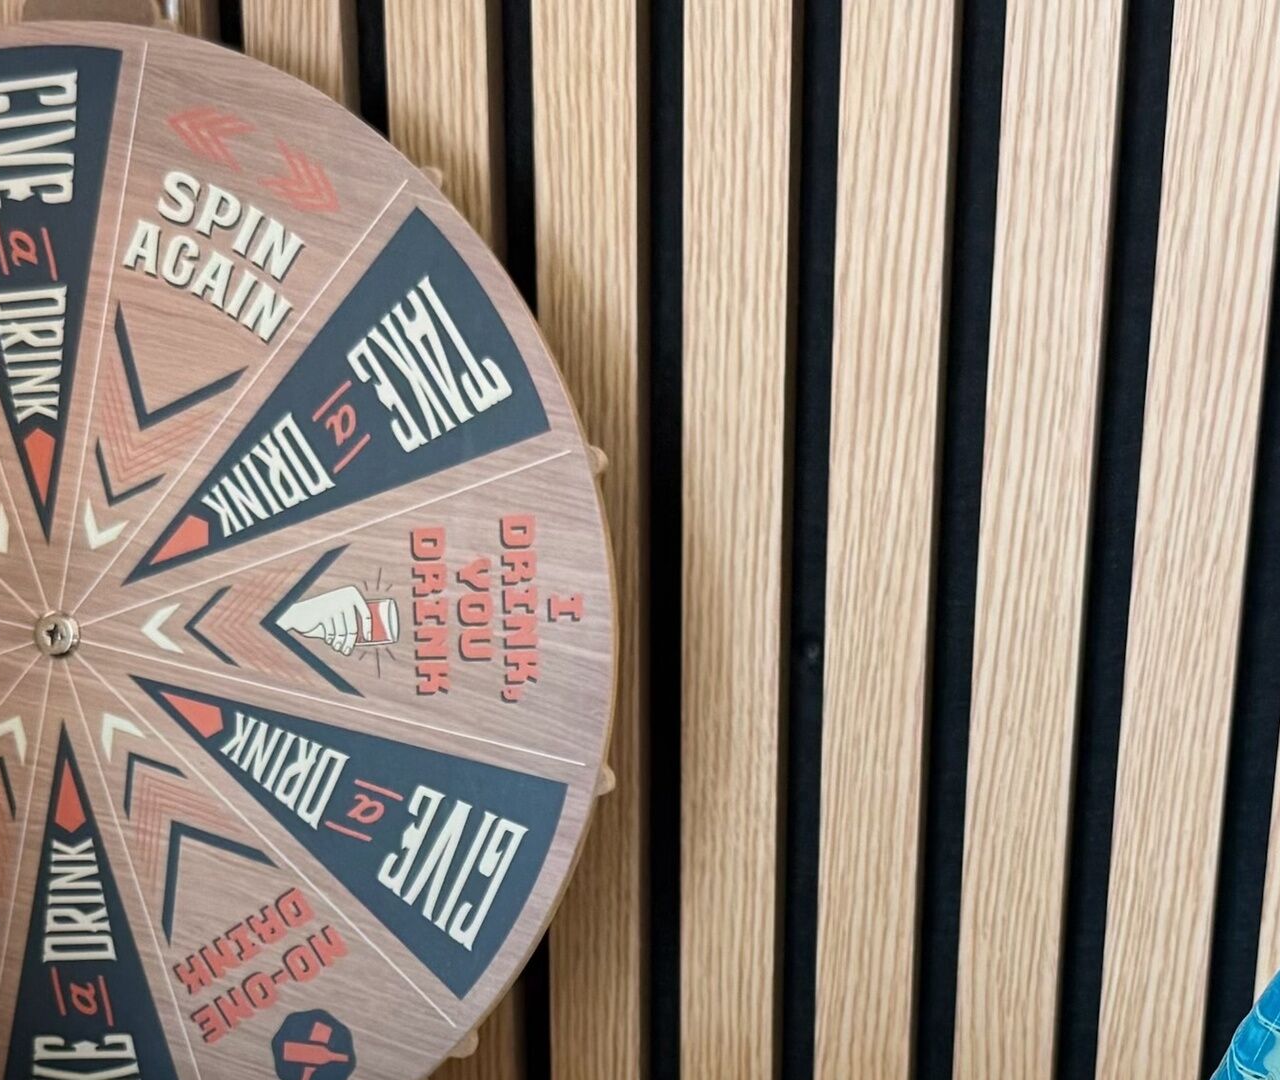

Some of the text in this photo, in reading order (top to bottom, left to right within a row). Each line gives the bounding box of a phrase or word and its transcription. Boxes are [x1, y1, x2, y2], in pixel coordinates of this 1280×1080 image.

[9, 227, 39, 267] a
[122, 220, 295, 344] AGAIN
[156, 170, 306, 283] SPIN
[201, 275, 512, 538] TAKE a DRINK
[409, 526, 449, 696] DRINK
[456, 556, 495, 663] YOU
[498, 512, 540, 703] DRINK,
[547, 592, 584, 623] I
[218, 711, 529, 952] GIVE a DRINK
[42, 836, 117, 964] DRINK
[173, 886, 316, 995] DRINK
[69, 981, 99, 1017] a
[189, 923, 350, 1045] NO-ONE
